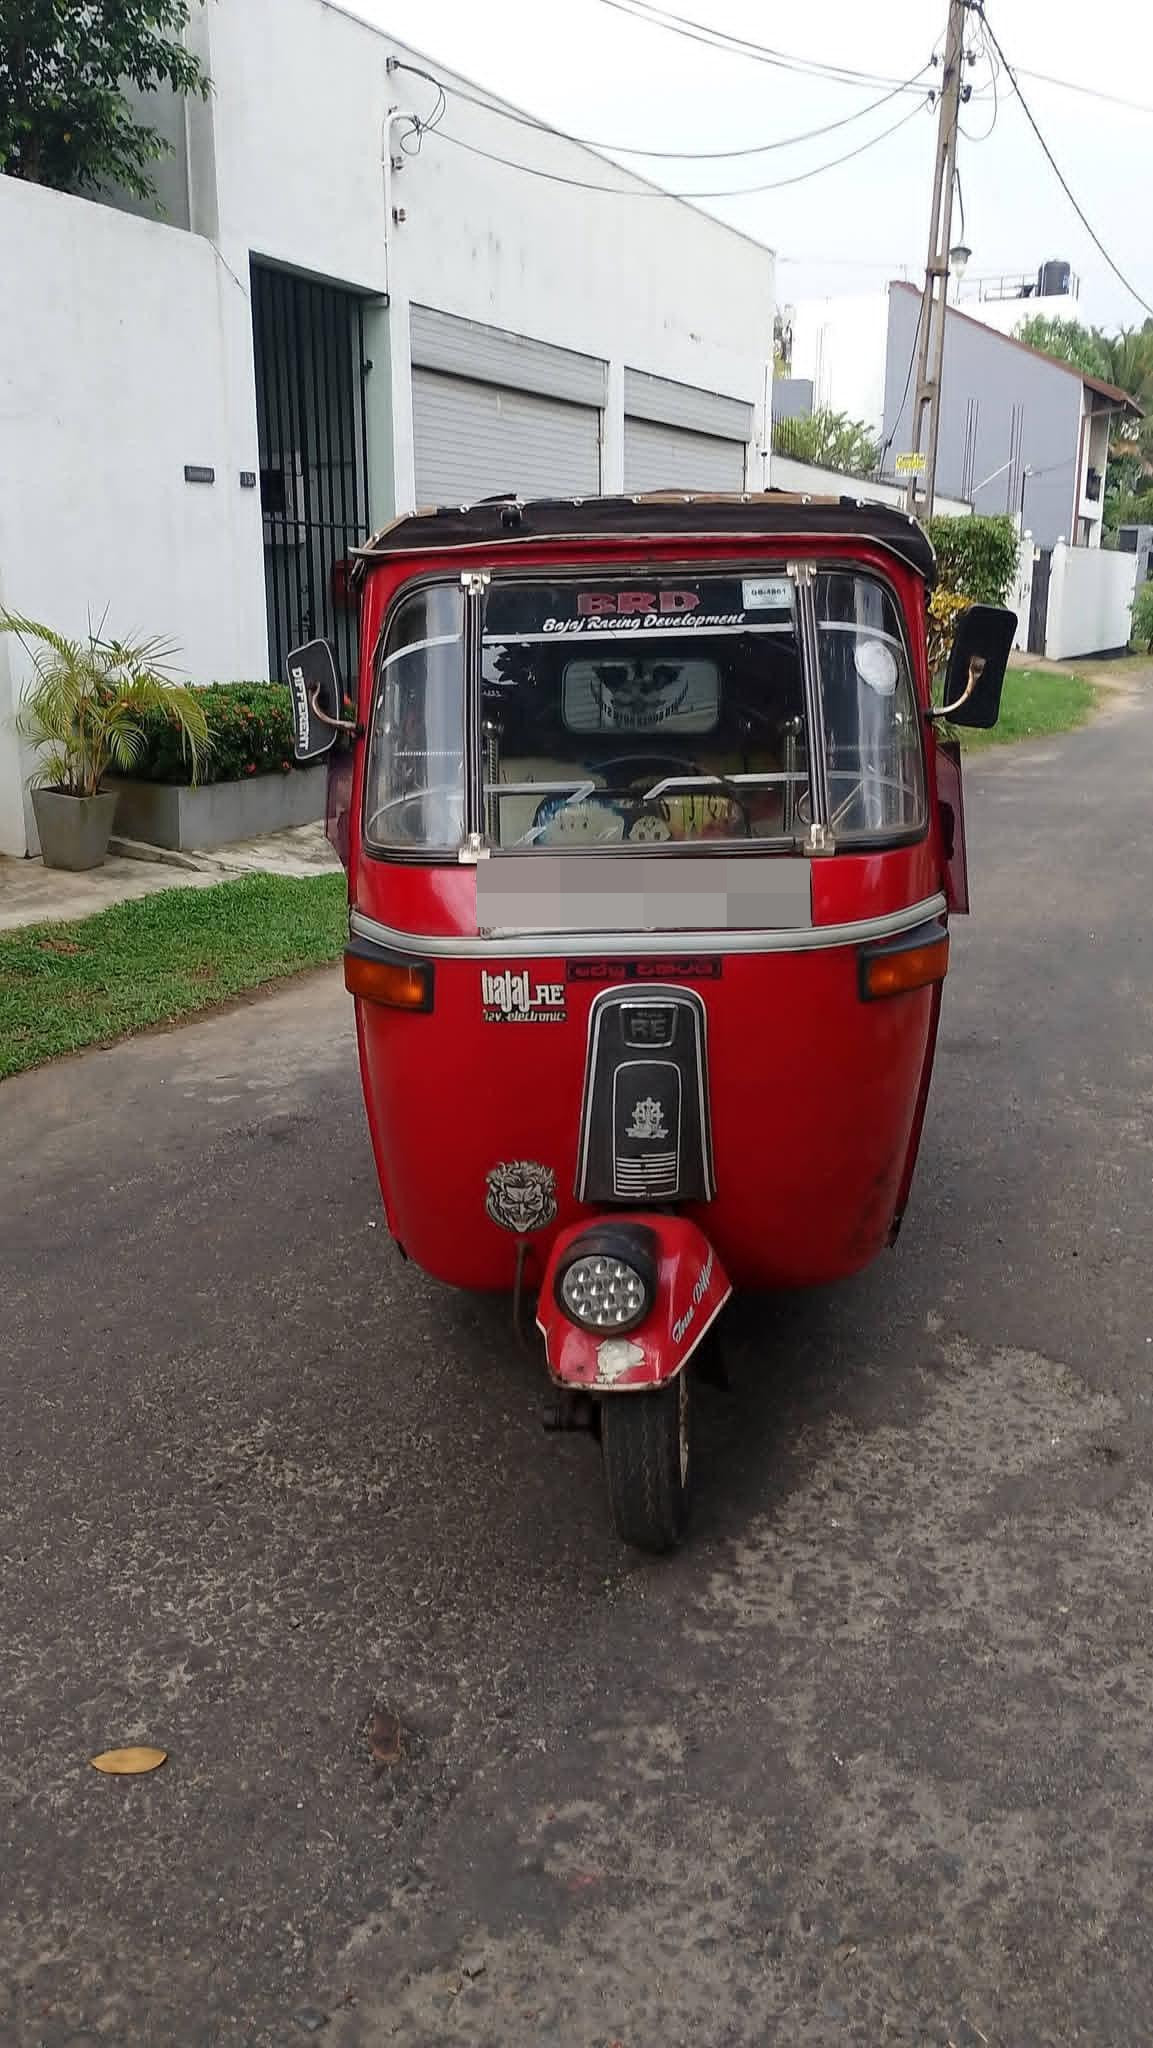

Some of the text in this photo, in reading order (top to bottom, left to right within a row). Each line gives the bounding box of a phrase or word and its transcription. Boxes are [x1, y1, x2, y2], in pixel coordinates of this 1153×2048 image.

[577, 591, 700, 616] BRD
[542, 612, 746, 634] Bajaj Racing Development
[291, 666, 309, 751] DIFFERENT
[481, 969, 530, 1013] bajaj
